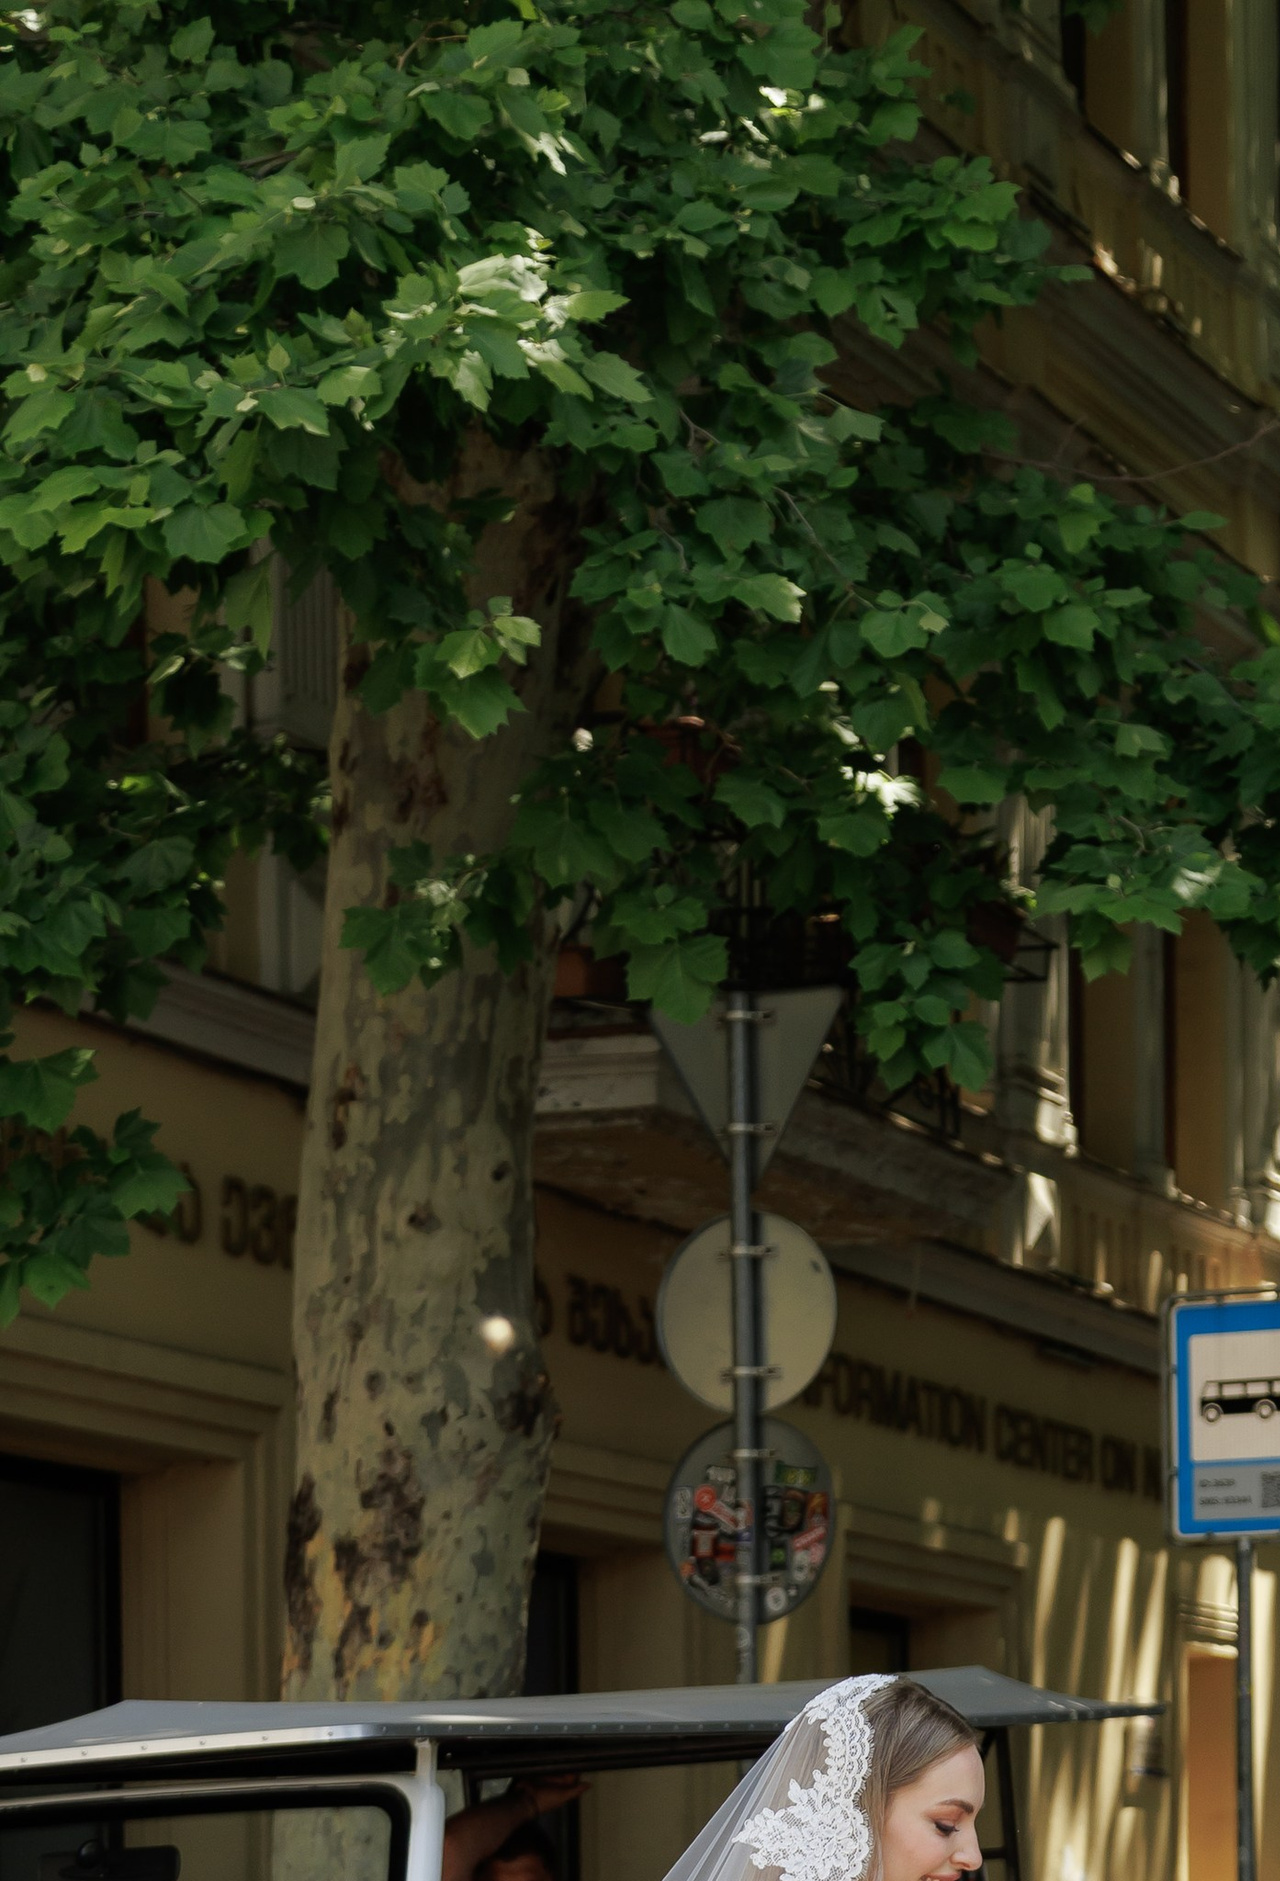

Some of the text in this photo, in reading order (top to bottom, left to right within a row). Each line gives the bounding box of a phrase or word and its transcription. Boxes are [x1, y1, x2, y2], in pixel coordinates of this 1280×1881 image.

[804, 1352, 986, 1452] FORMATION
[995, 1402, 1094, 1484] CENTER
[1101, 1434, 1137, 1495] ON
